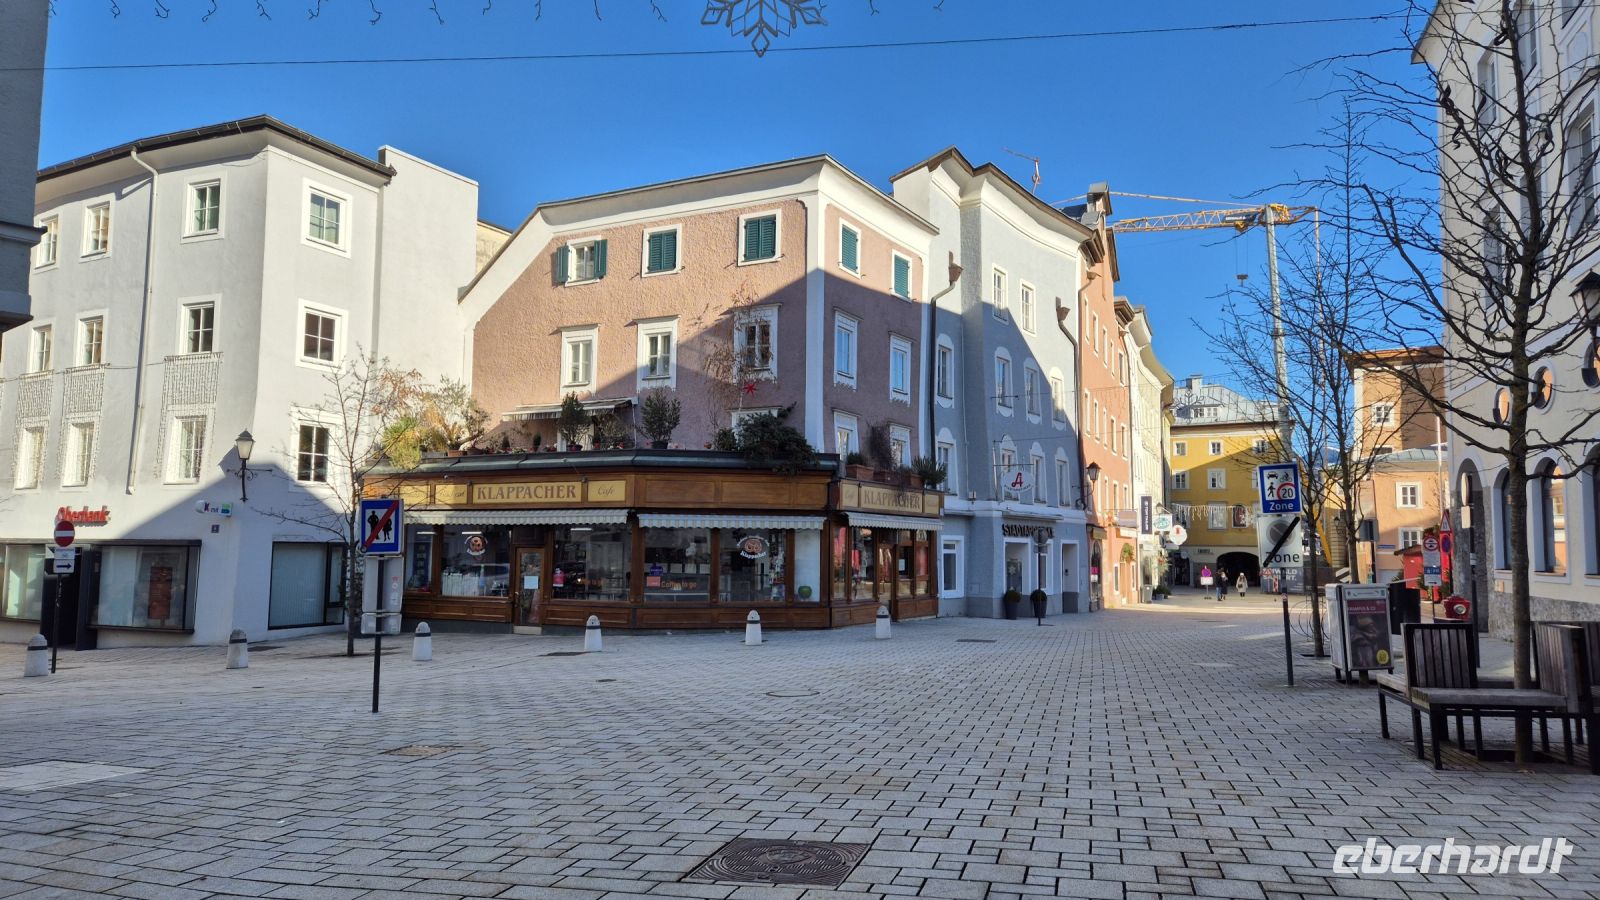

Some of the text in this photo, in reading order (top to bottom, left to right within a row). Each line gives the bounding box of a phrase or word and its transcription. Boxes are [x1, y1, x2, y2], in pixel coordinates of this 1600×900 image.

[477, 484, 577, 500] KLAPPACHER
[1282, 487, 1294, 499] 20
[1269, 502, 1294, 511] Zone
